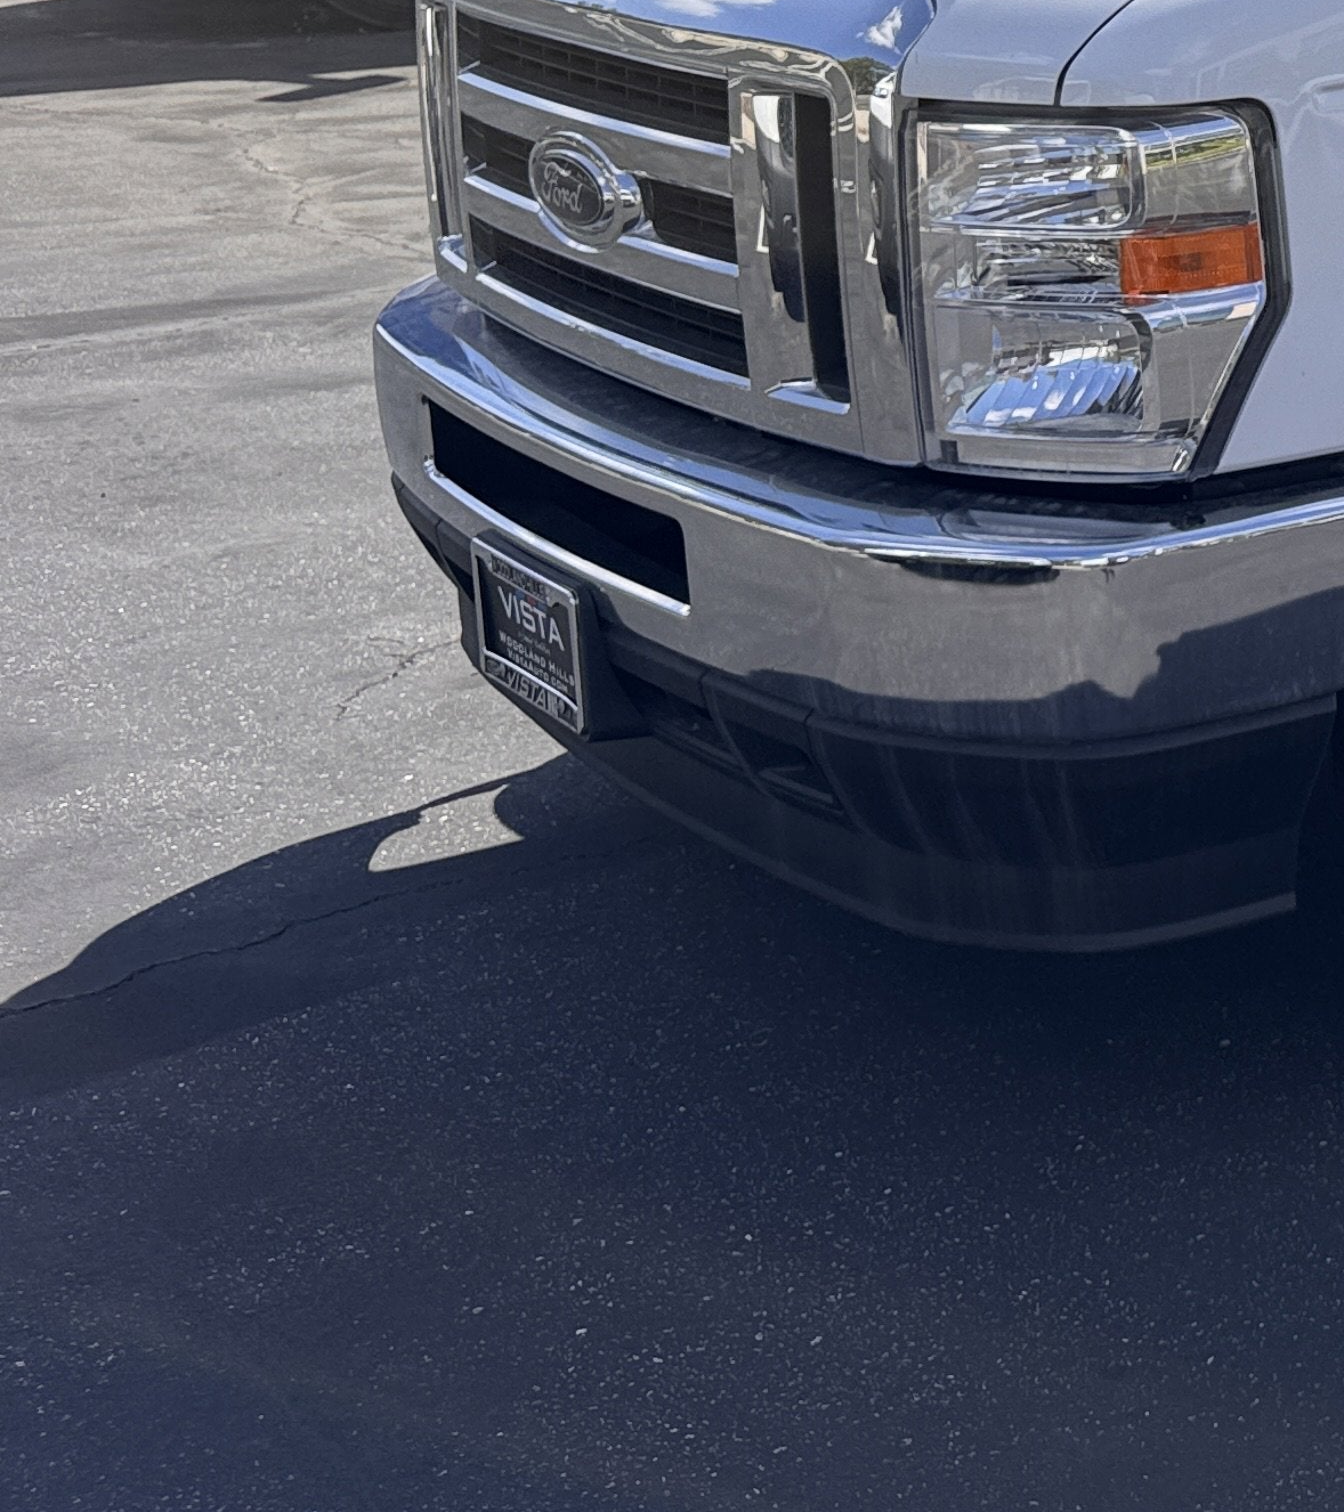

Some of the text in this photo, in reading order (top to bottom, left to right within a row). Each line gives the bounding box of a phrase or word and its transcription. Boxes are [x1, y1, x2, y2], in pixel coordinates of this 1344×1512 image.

[541, 161, 584, 214] Ford
[497, 585, 565, 652] VISTA
[498, 630, 547, 669] WOODLAND
[549, 660, 576, 686] HILLS
[507, 669, 549, 711] VISTA
